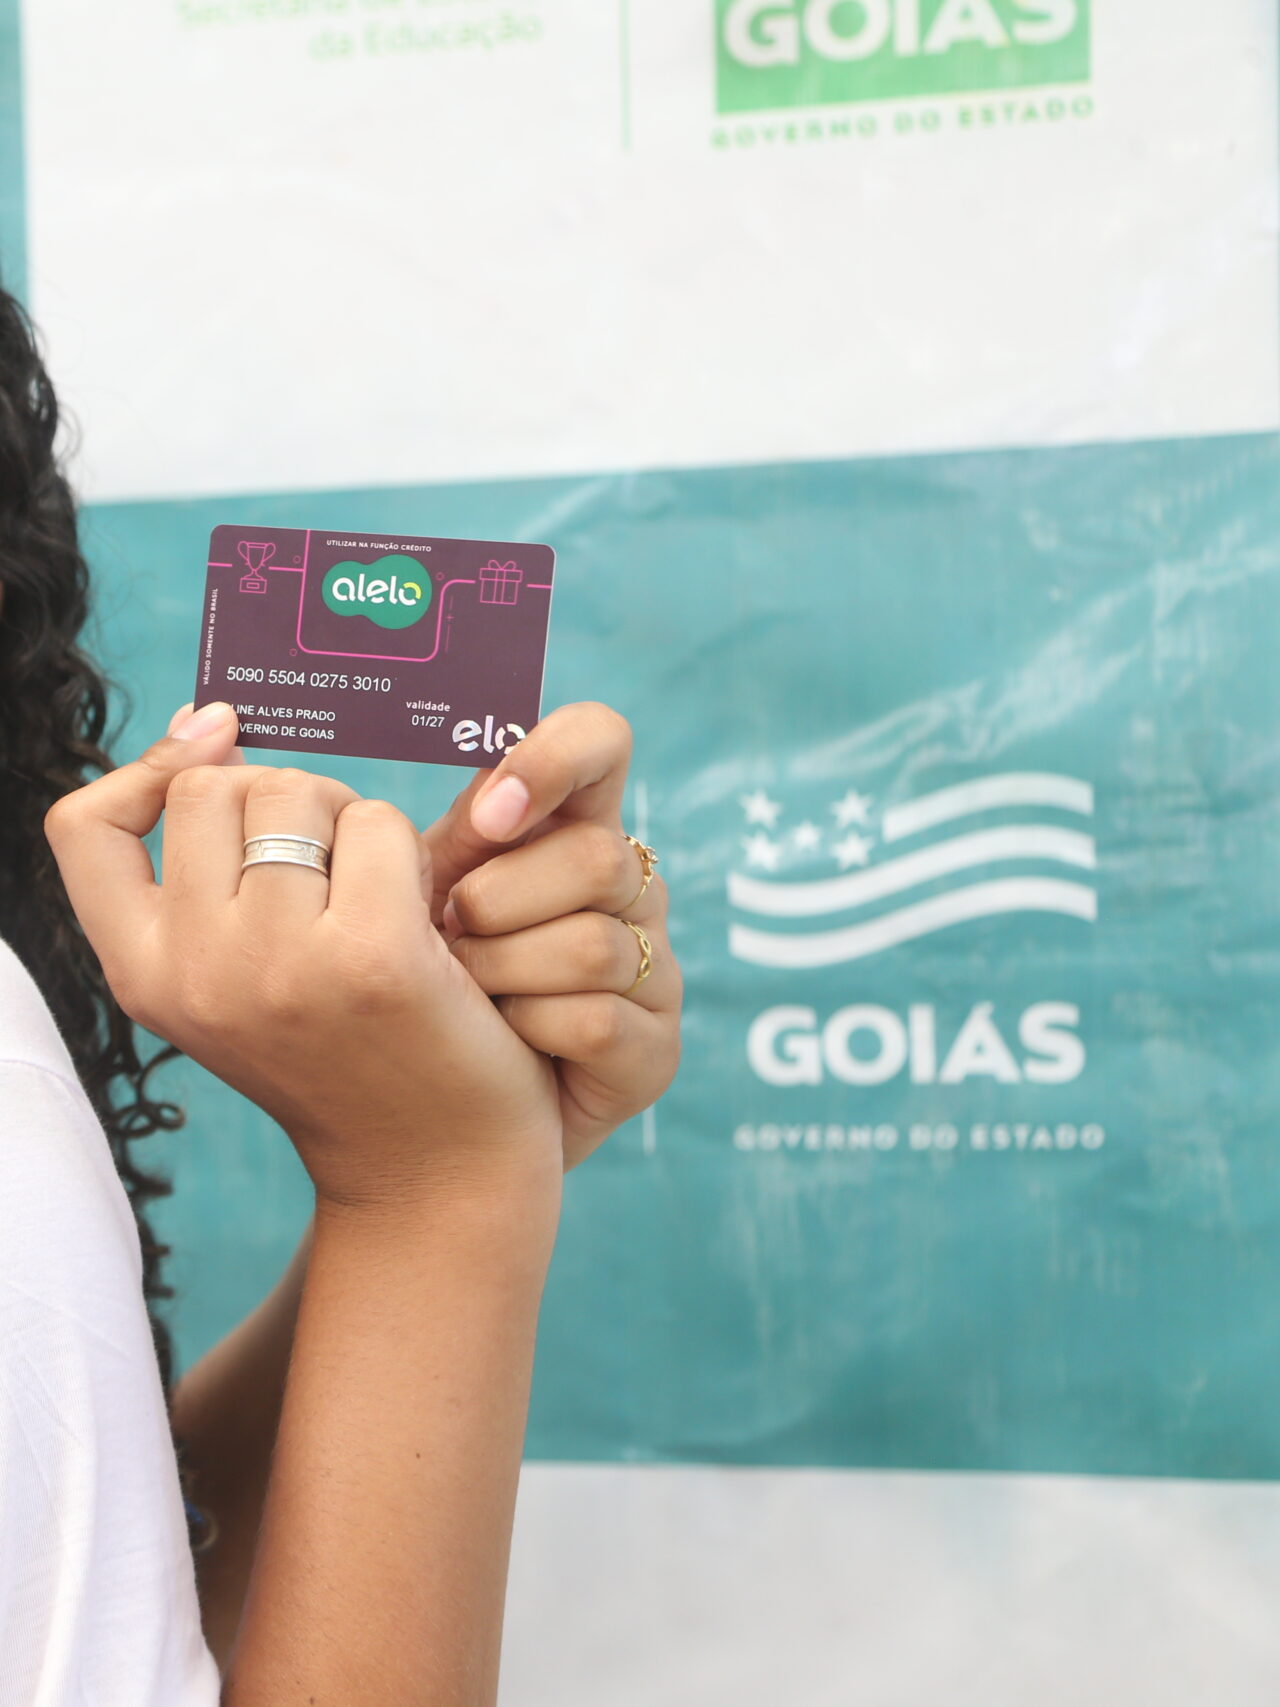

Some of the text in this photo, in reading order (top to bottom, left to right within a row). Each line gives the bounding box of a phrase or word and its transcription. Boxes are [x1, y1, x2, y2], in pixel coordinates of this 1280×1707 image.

[711, 95, 1094, 150] GOVERNO DO ESTADO
[326, 539, 357, 548] UTILIZAR
[370, 542, 399, 551] FUNÇÃO
[400, 544, 432, 553] CRÉDITO
[210, 588, 219, 612] BRASIL
[332, 573, 422, 606] alelo
[209, 612, 216, 624] NO
[206, 626, 214, 658] SOMENTE
[226, 666, 392, 693] 5090 5504 0275 3010
[231, 703, 336, 722] INE ALVES PRADO
[405, 700, 451, 712] validade
[239, 722, 335, 740] VERNO DE GOIAS
[411, 714, 445, 728] 01/27
[452, 715, 526, 755] elo
[746, 1001, 1086, 1087] GOIÁS
[733, 1122, 1105, 1151] GOVERNO DO ESTADO
